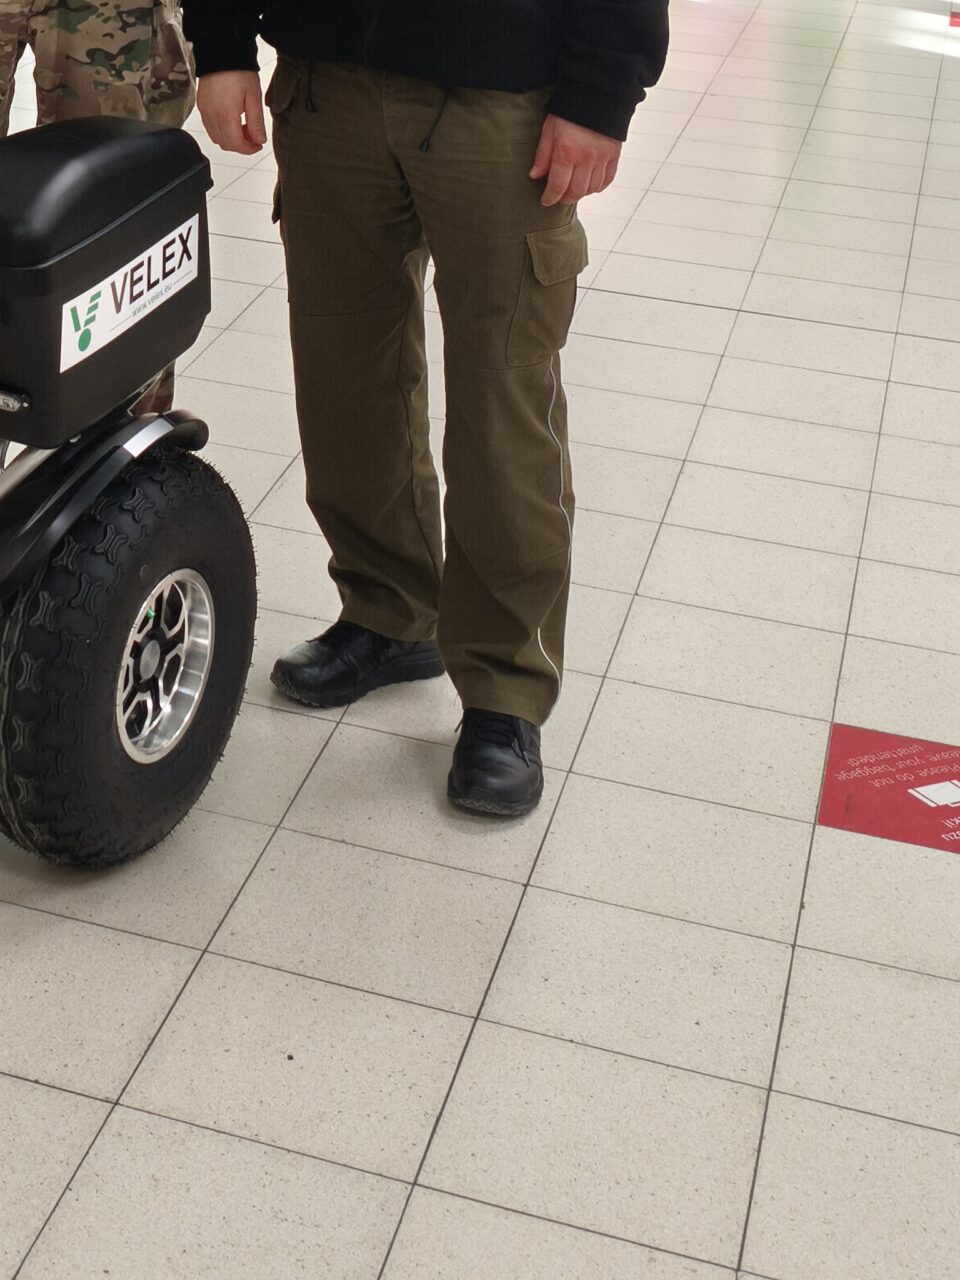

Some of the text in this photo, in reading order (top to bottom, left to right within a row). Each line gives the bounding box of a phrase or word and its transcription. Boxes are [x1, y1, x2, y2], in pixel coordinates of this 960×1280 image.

[110, 225, 194, 315] VELEX
[834, 750, 960, 782] eave your baggage
[868, 777, 895, 788] not
[895, 772, 915, 782] do
